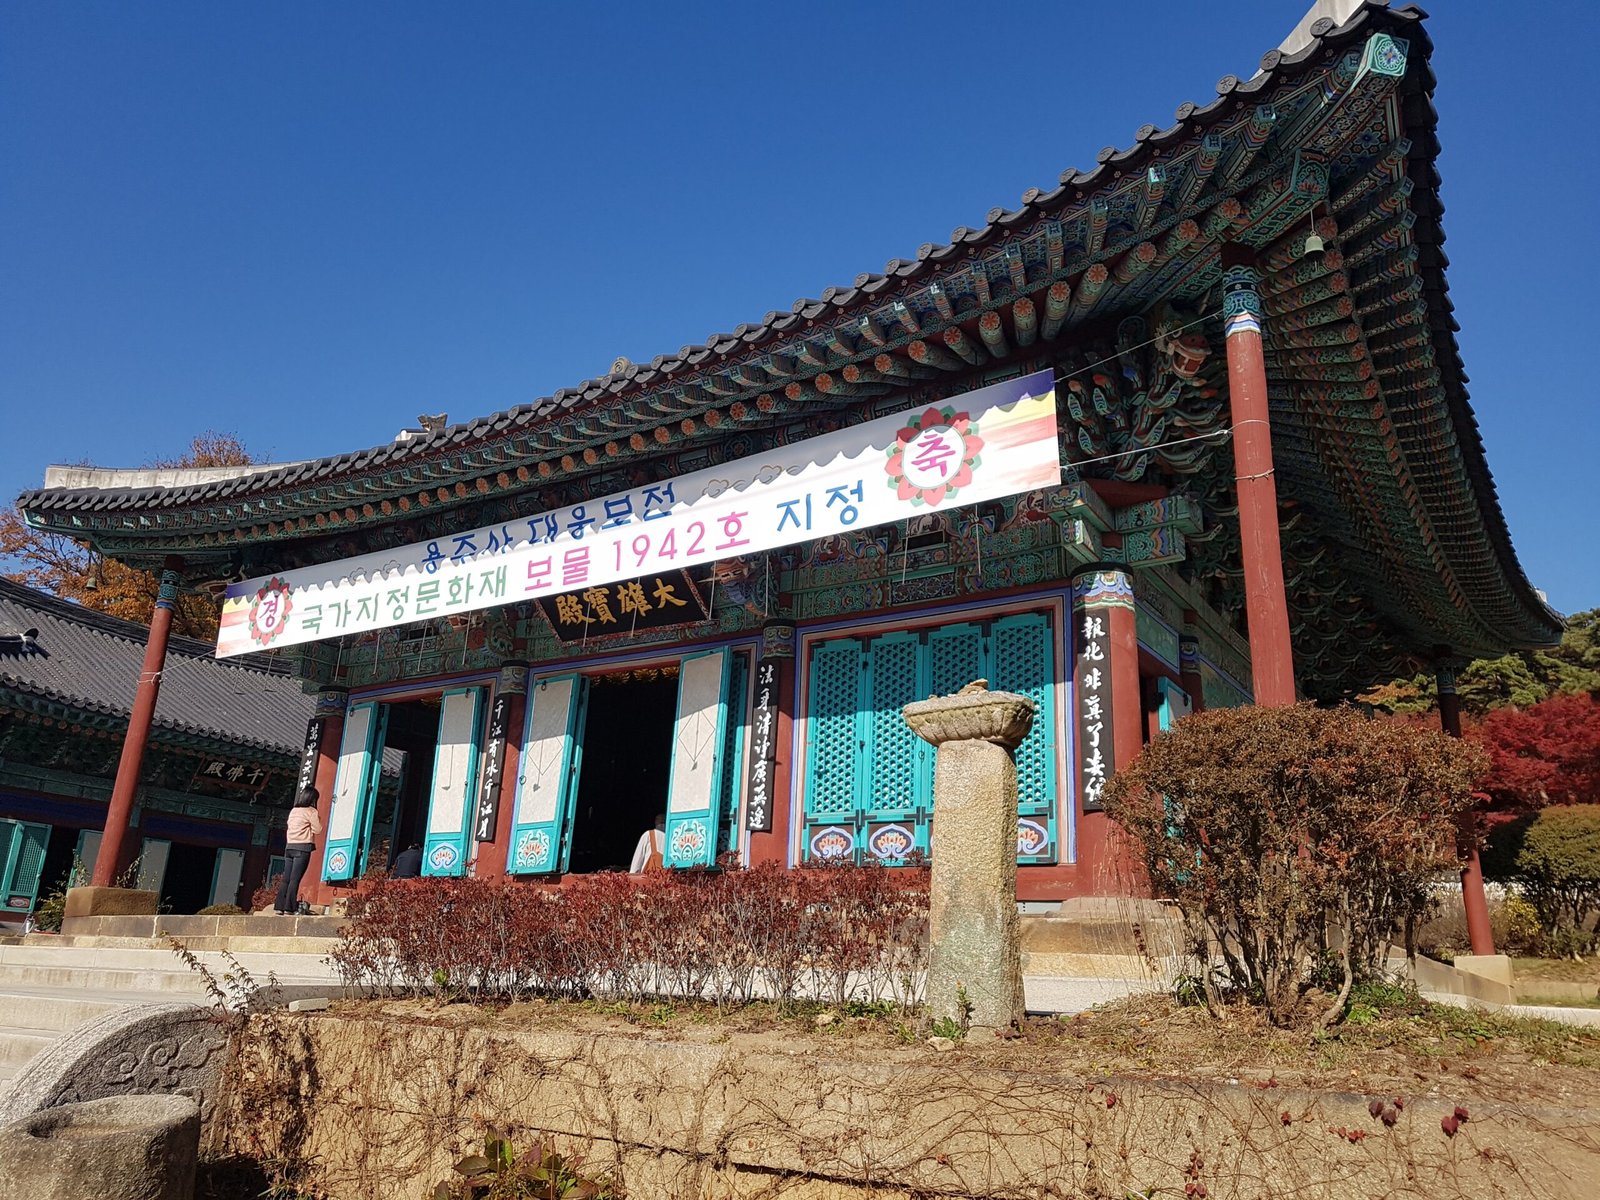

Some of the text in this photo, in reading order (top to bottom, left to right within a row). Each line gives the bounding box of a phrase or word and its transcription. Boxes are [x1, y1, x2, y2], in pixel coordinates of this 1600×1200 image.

[910, 433, 956, 477] 축
[422, 481, 676, 575] 용주사 대웅보전
[302, 480, 864, 634] 국가지정문화재 보물 1942호 지정
[259, 595, 279, 628] 경
[555, 577, 688, 626] 大雄寶殿
[204, 761, 264, 785] 千佛殿
